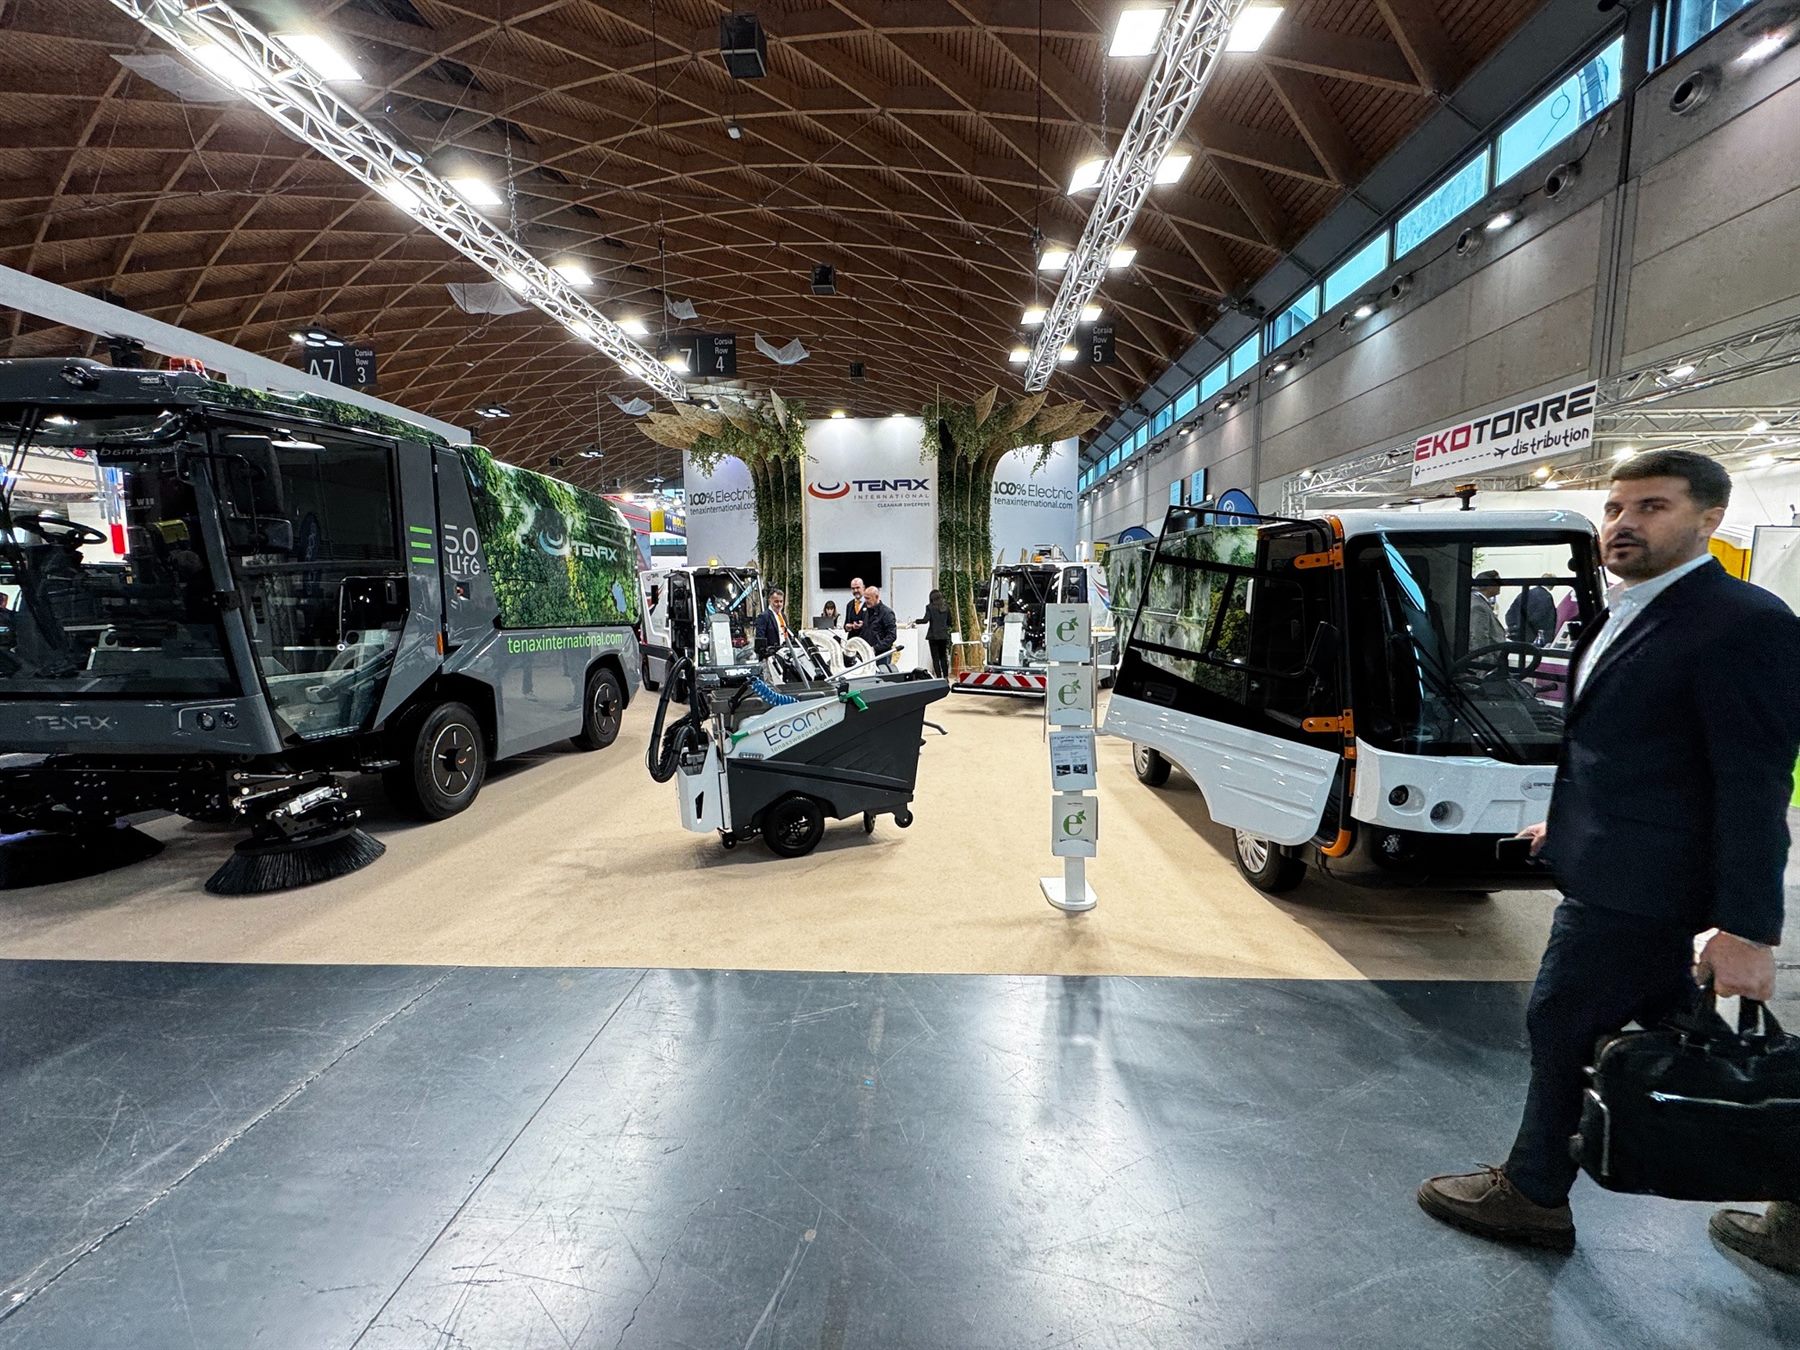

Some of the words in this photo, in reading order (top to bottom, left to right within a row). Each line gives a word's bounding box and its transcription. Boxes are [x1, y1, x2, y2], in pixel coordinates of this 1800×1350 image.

[714, 337, 733, 345] Corsia
[354, 349, 373, 357] Corsia
[714, 347, 728, 355] Row
[1093, 345, 1102, 363] 5
[309, 359, 335, 382] A7
[355, 358, 369, 366] Row
[715, 356, 725, 373] 4
[357, 366, 366, 384] 3
[1414, 385, 1597, 462] EKOTORRE
[1511, 427, 1590, 456] distribution
[852, 479, 931, 492] TENAX
[994, 481, 1027, 496] 100%
[1028, 484, 1074, 500] Electric
[689, 491, 715, 506] 100%
[994, 497, 1073, 510] tenaxinternational.com
[444, 524, 479, 556] 5.0
[570, 540, 618, 562] TENAX
[507, 632, 623, 654] tenaxinternational.com
[35, 715, 113, 731] TENAX
